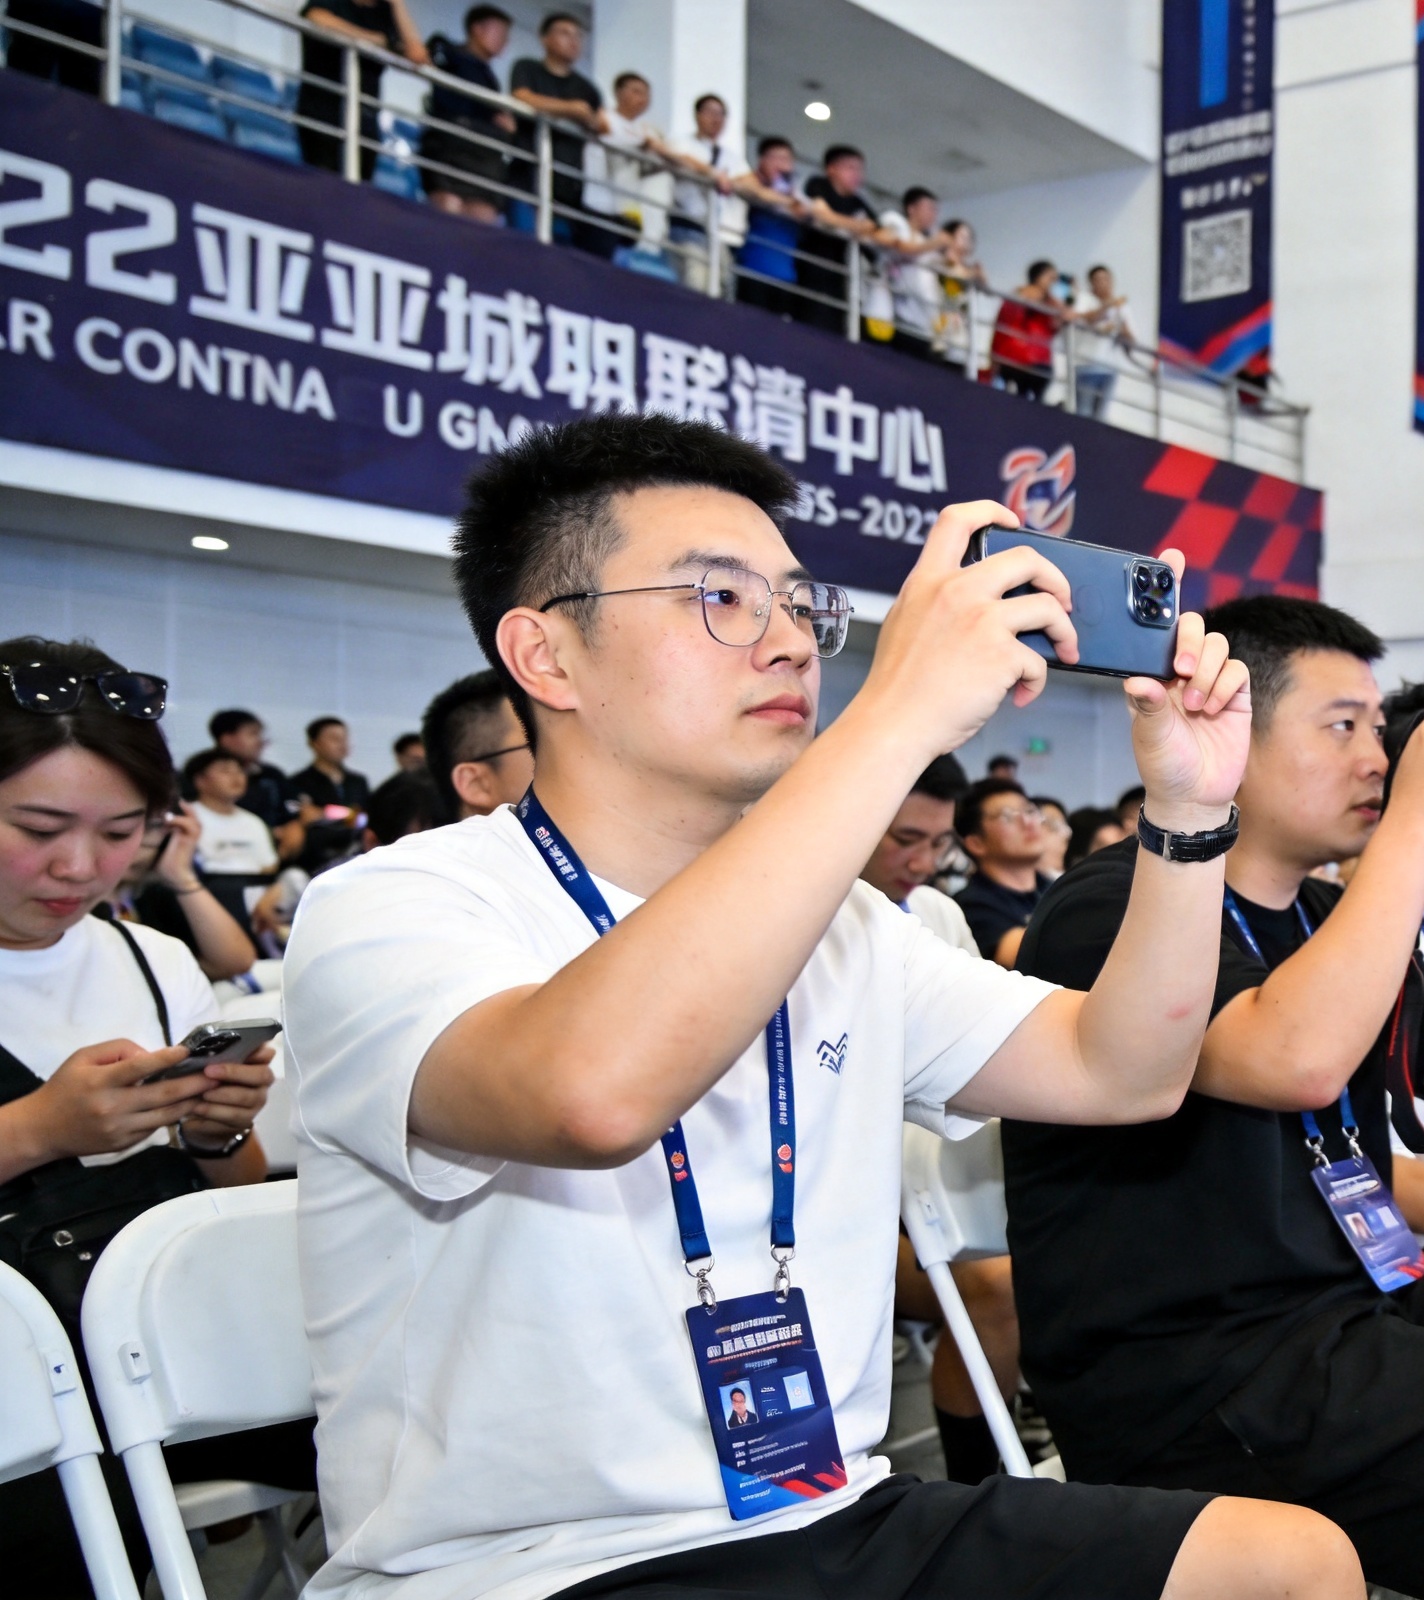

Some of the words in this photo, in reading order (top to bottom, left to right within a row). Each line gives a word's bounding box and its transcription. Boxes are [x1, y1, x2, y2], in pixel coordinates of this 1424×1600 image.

[0, 298, 55, 361] R
[74, 315, 338, 422] CONTNA
[383, 384, 424, 439] U
